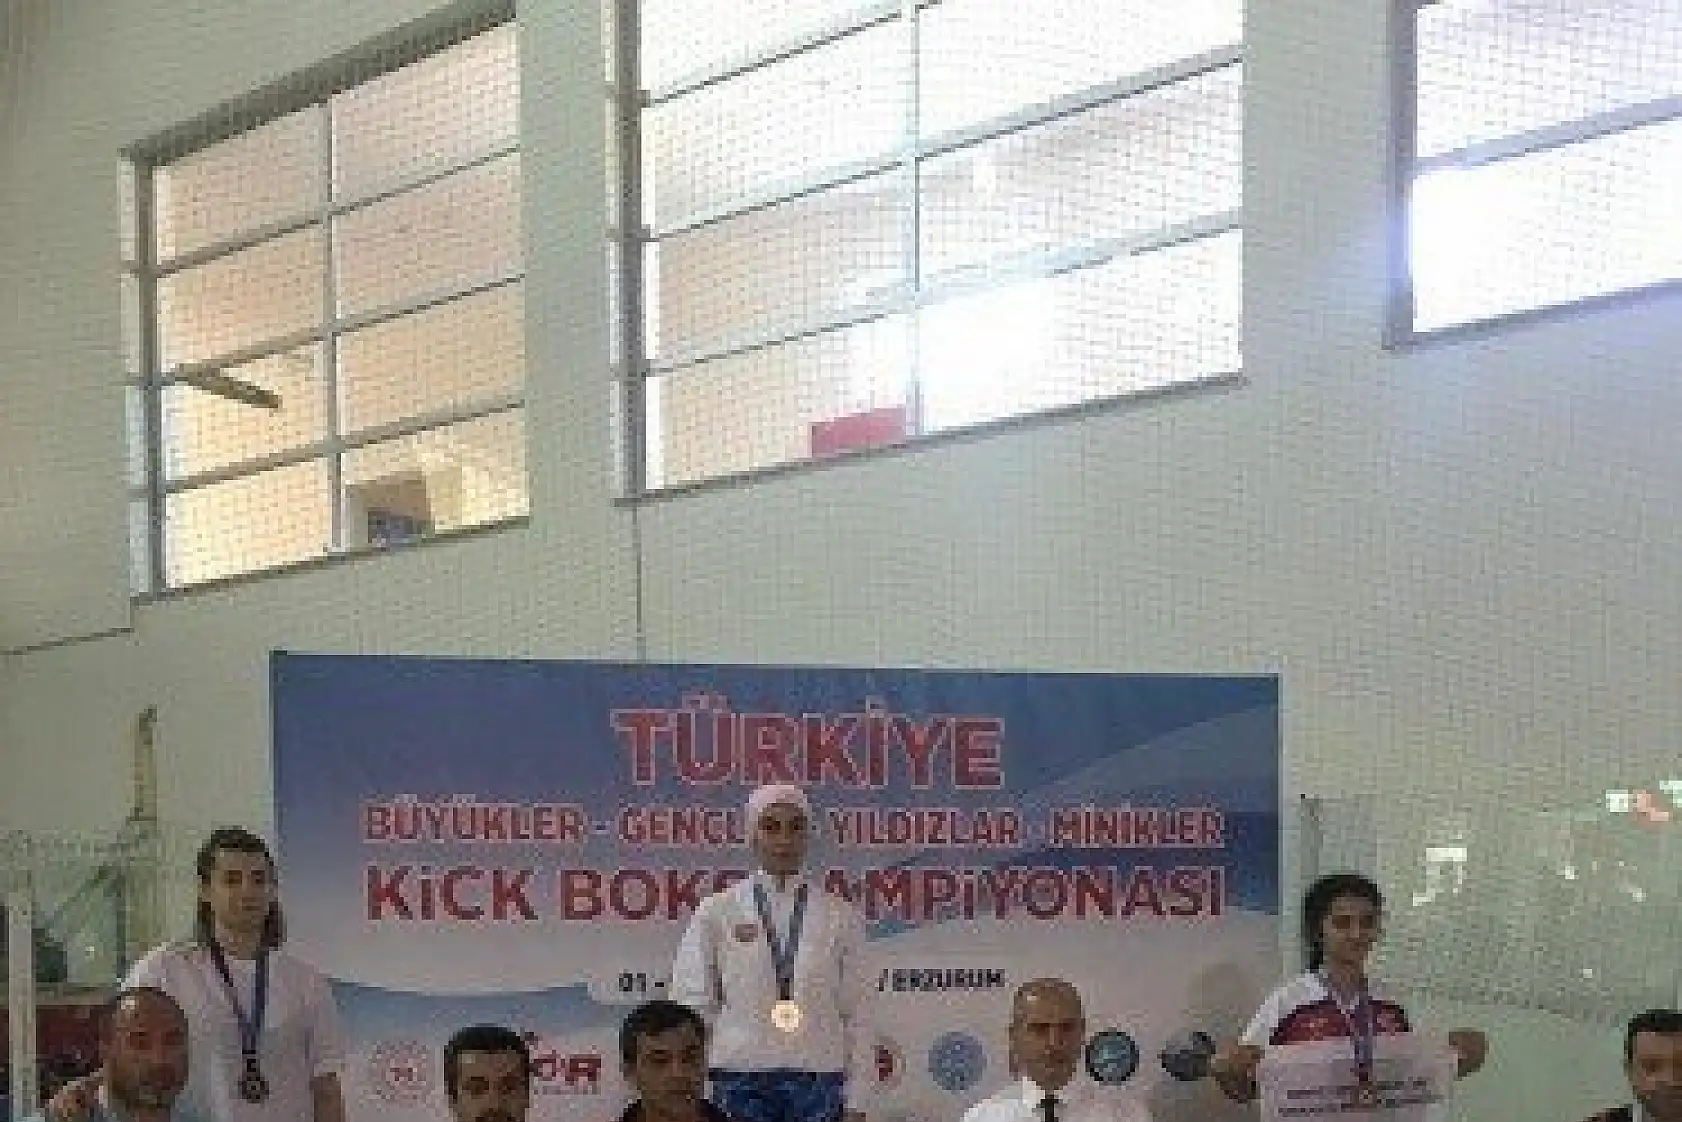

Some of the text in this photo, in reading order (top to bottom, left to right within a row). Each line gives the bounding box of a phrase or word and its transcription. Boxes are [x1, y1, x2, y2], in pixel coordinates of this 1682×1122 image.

[611, 692, 1005, 789] TÜRKİYE
[363, 794, 587, 843] BÜYÜKLER
[830, 807, 1019, 847] YILDIZLAR
[1050, 802, 1226, 848] MİNİKLER
[618, 971, 647, 993] 01
